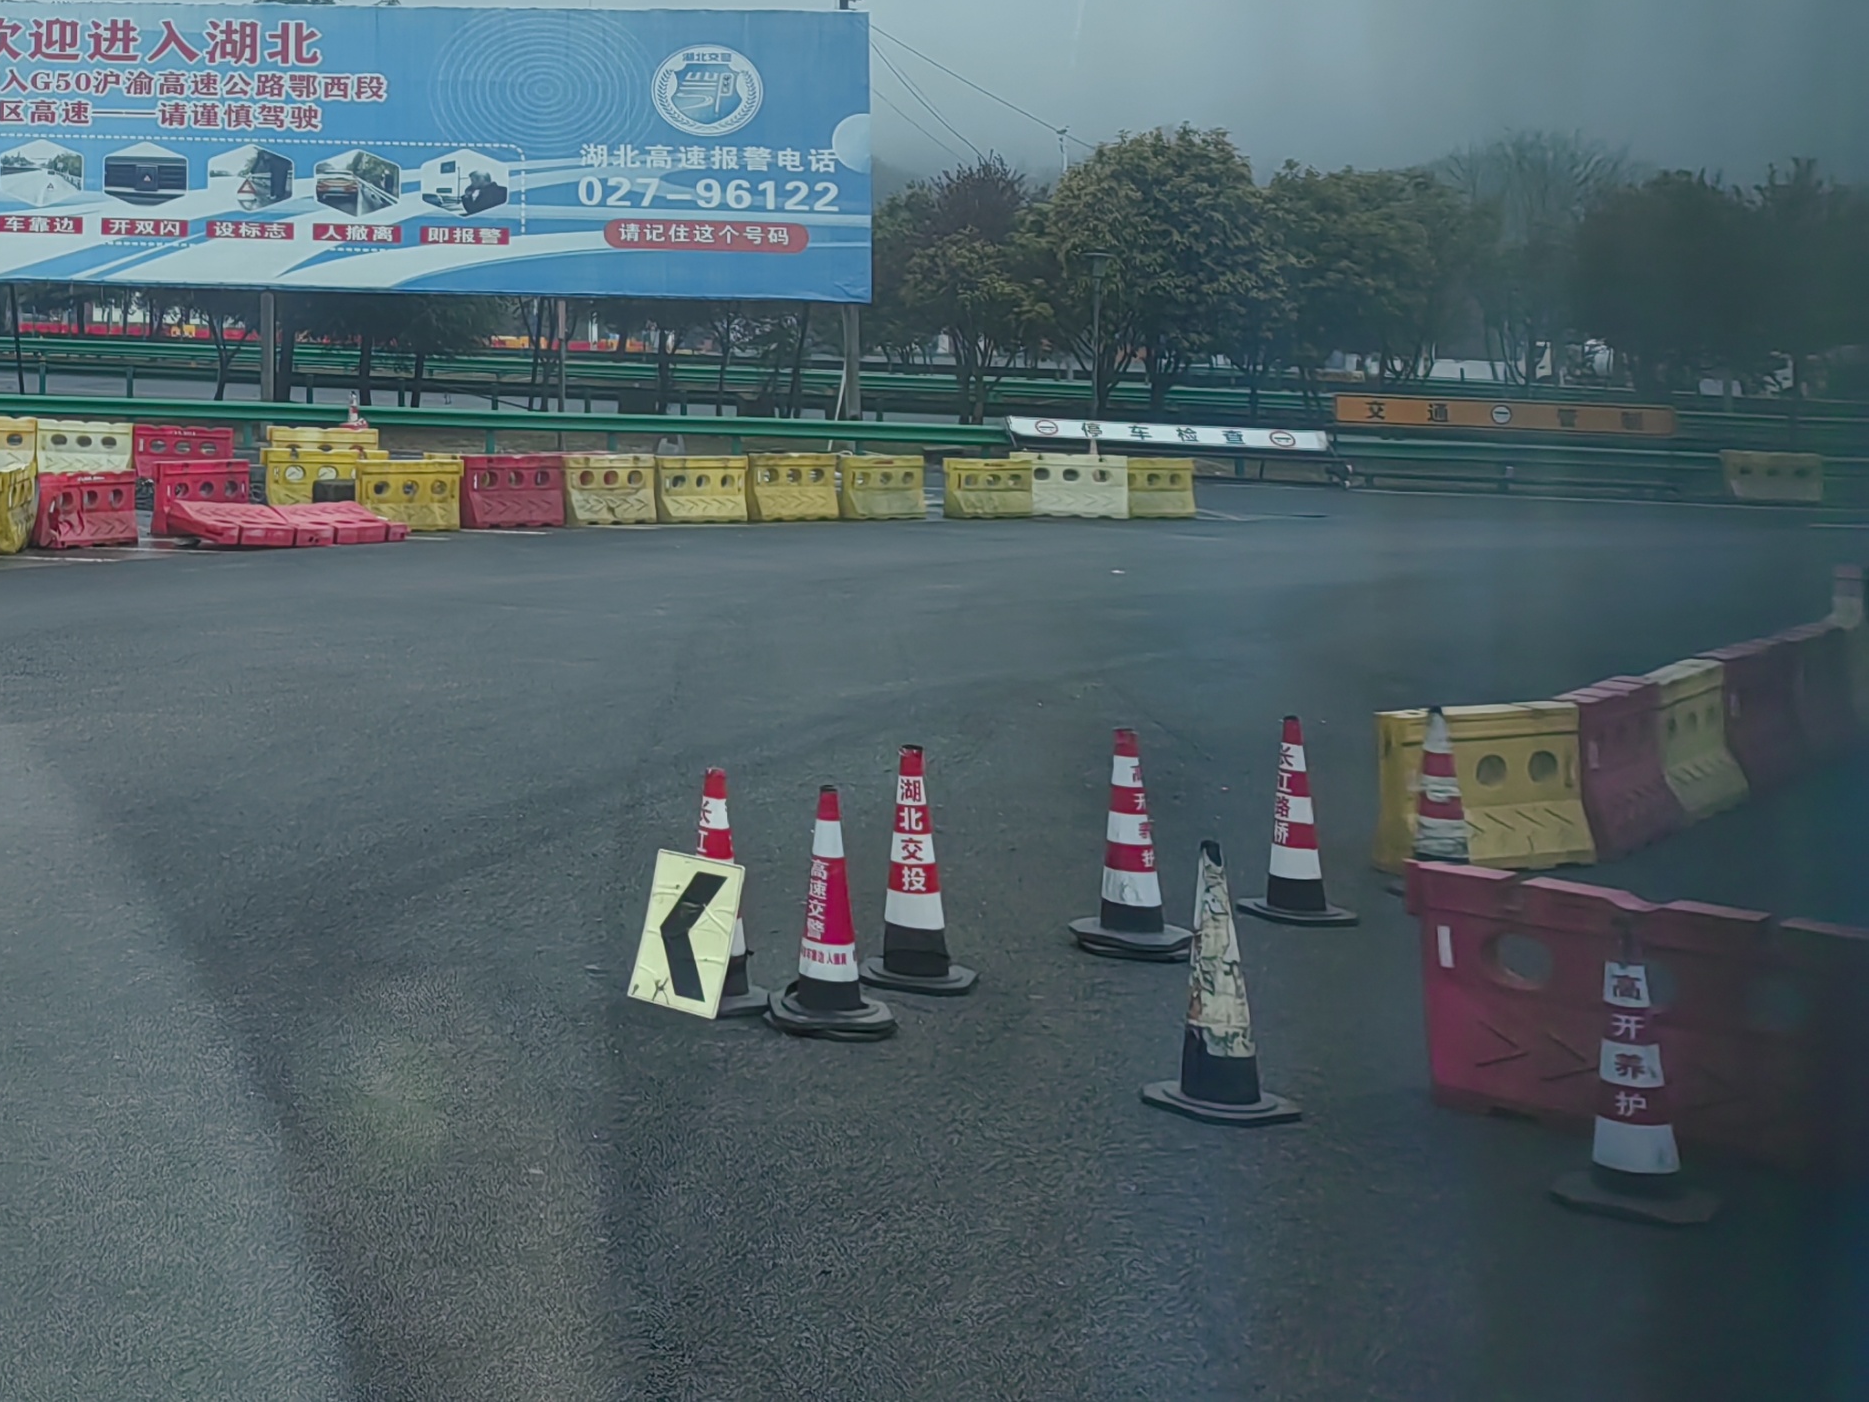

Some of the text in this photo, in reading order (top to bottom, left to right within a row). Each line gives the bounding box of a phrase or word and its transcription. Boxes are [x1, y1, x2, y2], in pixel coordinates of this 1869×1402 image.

[580, 144, 837, 174] 湖北高速报警电话
[578, 176, 839, 212] 027-96122
[4, 216, 76, 234] 车靠边
[108, 219, 182, 237] 开双闪
[213, 221, 288, 239] 设标志
[321, 224, 394, 243] 人撤离
[428, 227, 502, 245] 即报警
[618, 222, 790, 246] 请记住这个号码
[1081, 422, 1246, 445] 停车检查
[900, 778, 927, 892] 湖北交投
[806, 858, 830, 940] 高速交警
